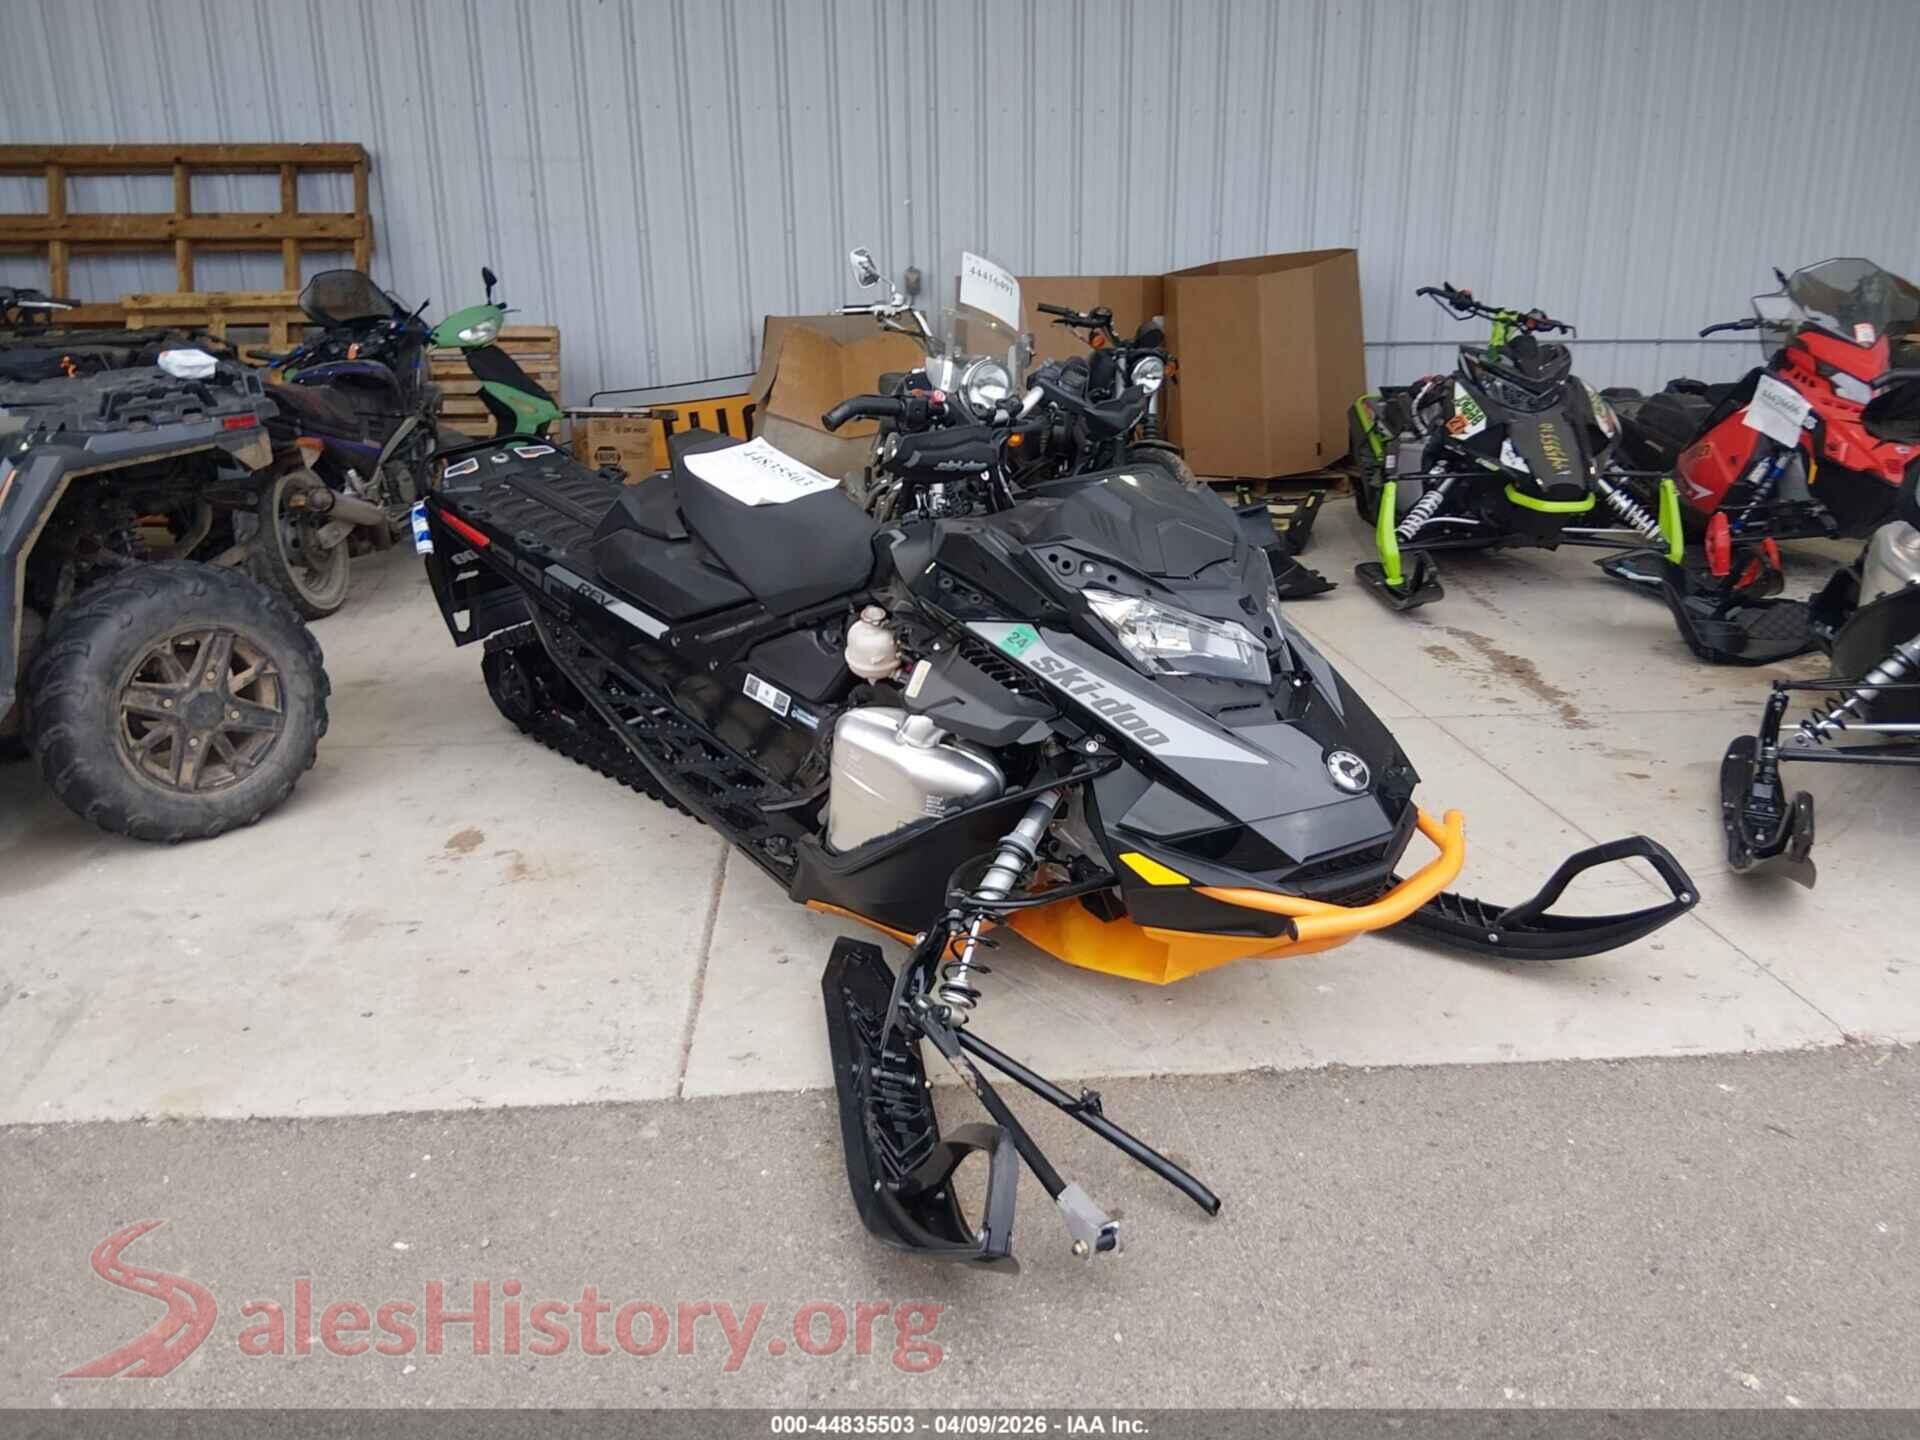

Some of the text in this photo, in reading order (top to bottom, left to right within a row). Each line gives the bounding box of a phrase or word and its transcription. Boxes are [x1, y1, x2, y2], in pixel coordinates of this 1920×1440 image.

[576, 582, 621, 606] REV
[1005, 631, 1030, 648] 24
[1028, 655, 1171, 747] ski-doo
